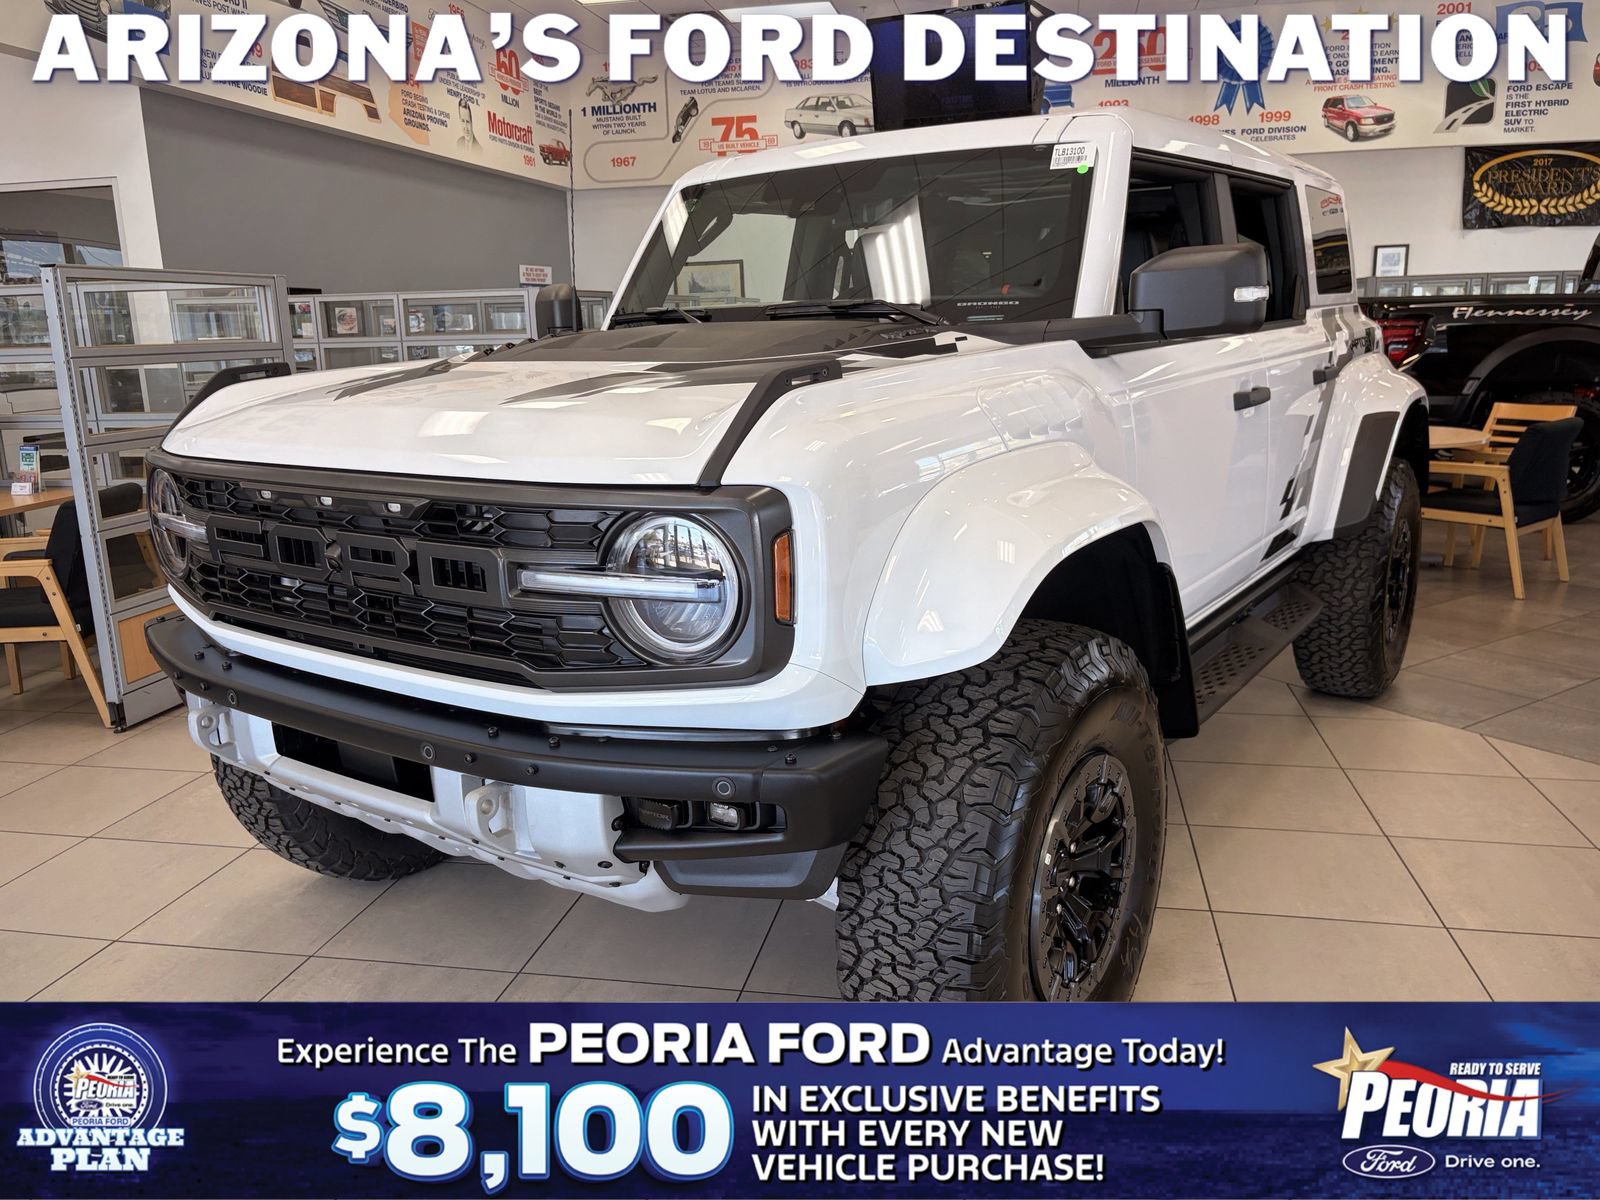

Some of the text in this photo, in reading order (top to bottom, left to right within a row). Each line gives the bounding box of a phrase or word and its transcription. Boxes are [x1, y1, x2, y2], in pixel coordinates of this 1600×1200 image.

[212, 1, 230, 14] POST
[1436, 2, 1473, 15] 2001
[1104, 76, 1160, 88] MILLIONTH
[1313, 81, 1396, 92] FRONT CRASH TESTING.
[1507, 82, 1573, 93] FORD ESCAPE
[241, 82, 268, 96] WOODIE
[731, 85, 761, 93] MCLAREN.
[581, 102, 657, 117] 1 MILLIONTH
[1505, 99, 1569, 109] FIRST HYBRID
[403, 108, 448, 128] ARIZONA PROVING
[1259, 110, 1292, 123] 1999
[1505, 109, 1549, 117] ELECTRIC
[1504, 118, 1522, 126] SUV
[488, 110, 534, 147] Motorcraft
[1241, 127, 1266, 136] FORD
[1268, 125, 1307, 134] DIVISION
[711, 115, 760, 157] 75
[1250, 134, 1296, 142] CELEBRATES
[1055, 146, 1086, 157] TLB13100
[611, 157, 637, 168] 1967
[1533, 158, 1553, 167] 2017
[1487, 166, 1600, 185] PRESIDENT'S
[1511, 181, 1573, 197] AWARD
[1452, 306, 1593, 320] Hennessey
[206, 513, 509, 603] FORD
